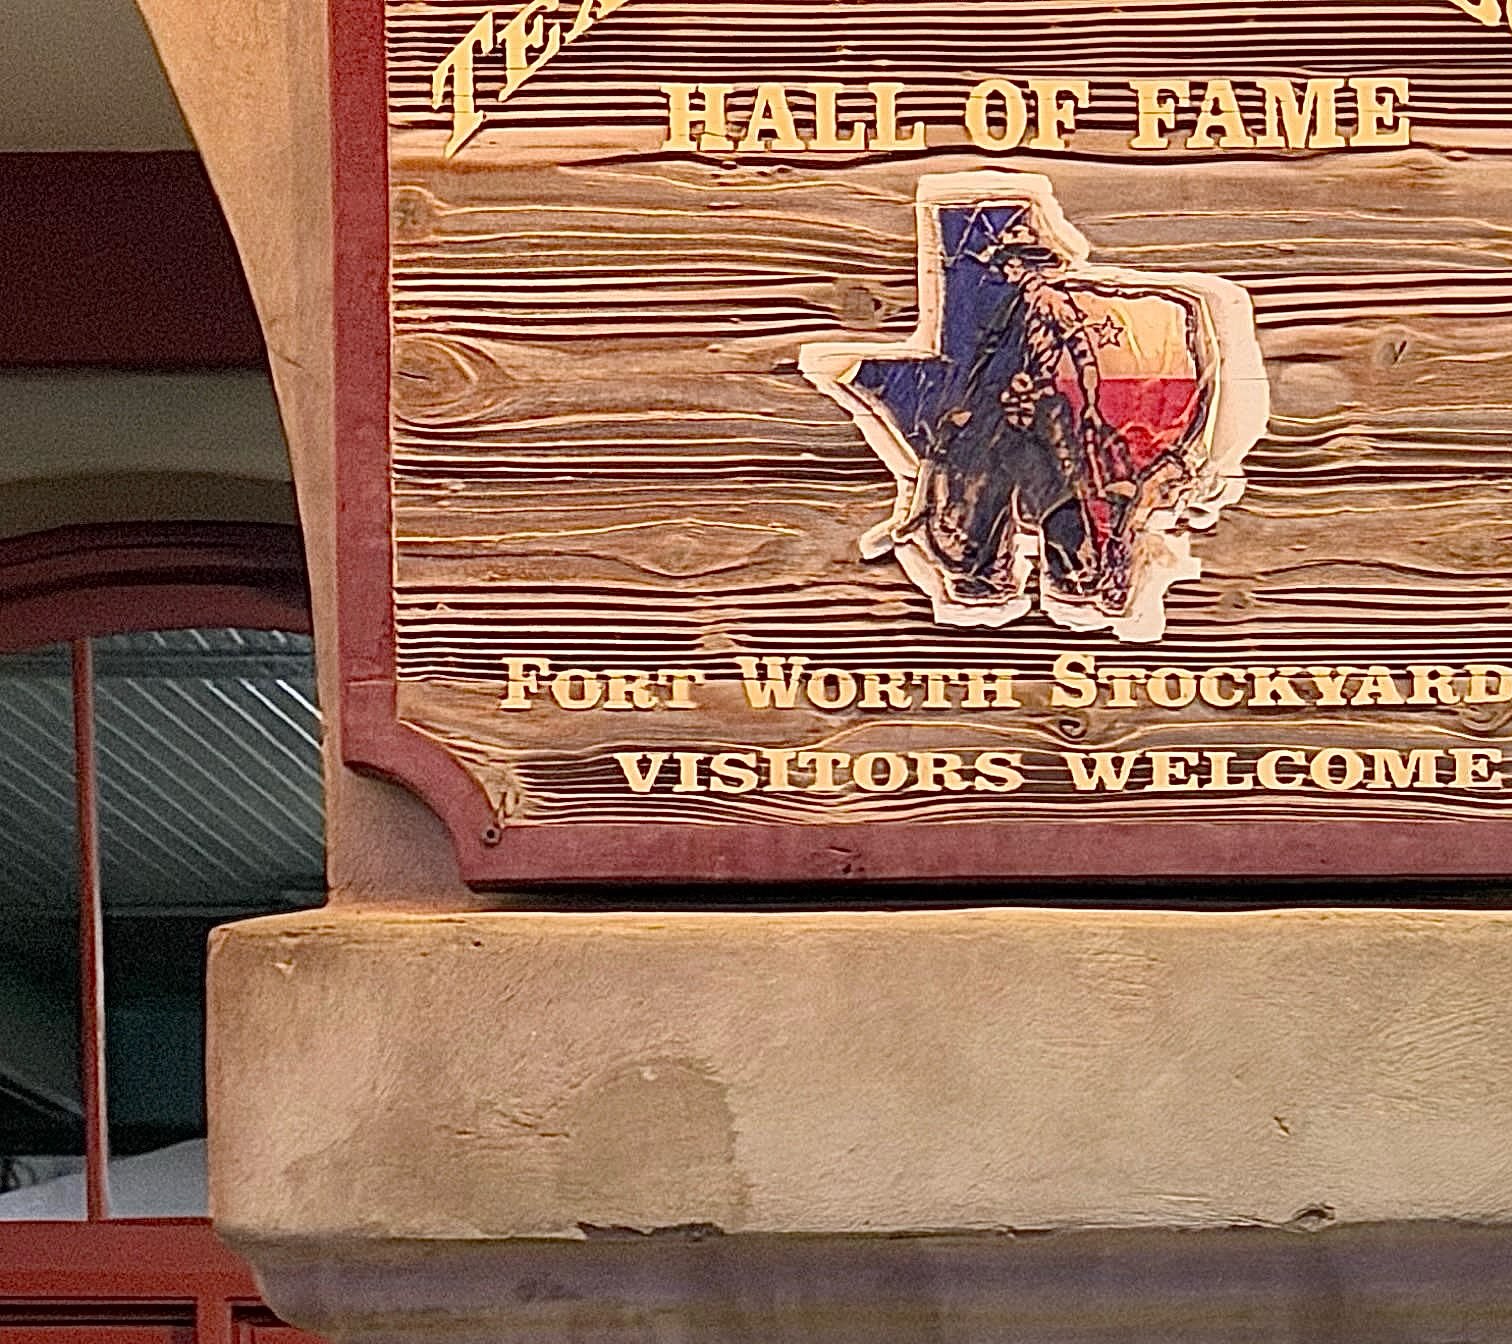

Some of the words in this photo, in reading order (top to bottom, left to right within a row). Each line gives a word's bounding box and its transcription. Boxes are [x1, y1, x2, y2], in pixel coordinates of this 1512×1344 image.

[659, 81, 927, 151] HALL
[965, 78, 1089, 151] OF
[1128, 77, 1411, 150] FAME
[501, 656, 704, 710] FORT
[735, 656, 1022, 709] WORTH
[614, 751, 1025, 793] VISITORS
[1061, 748, 1503, 790] WELCOME
